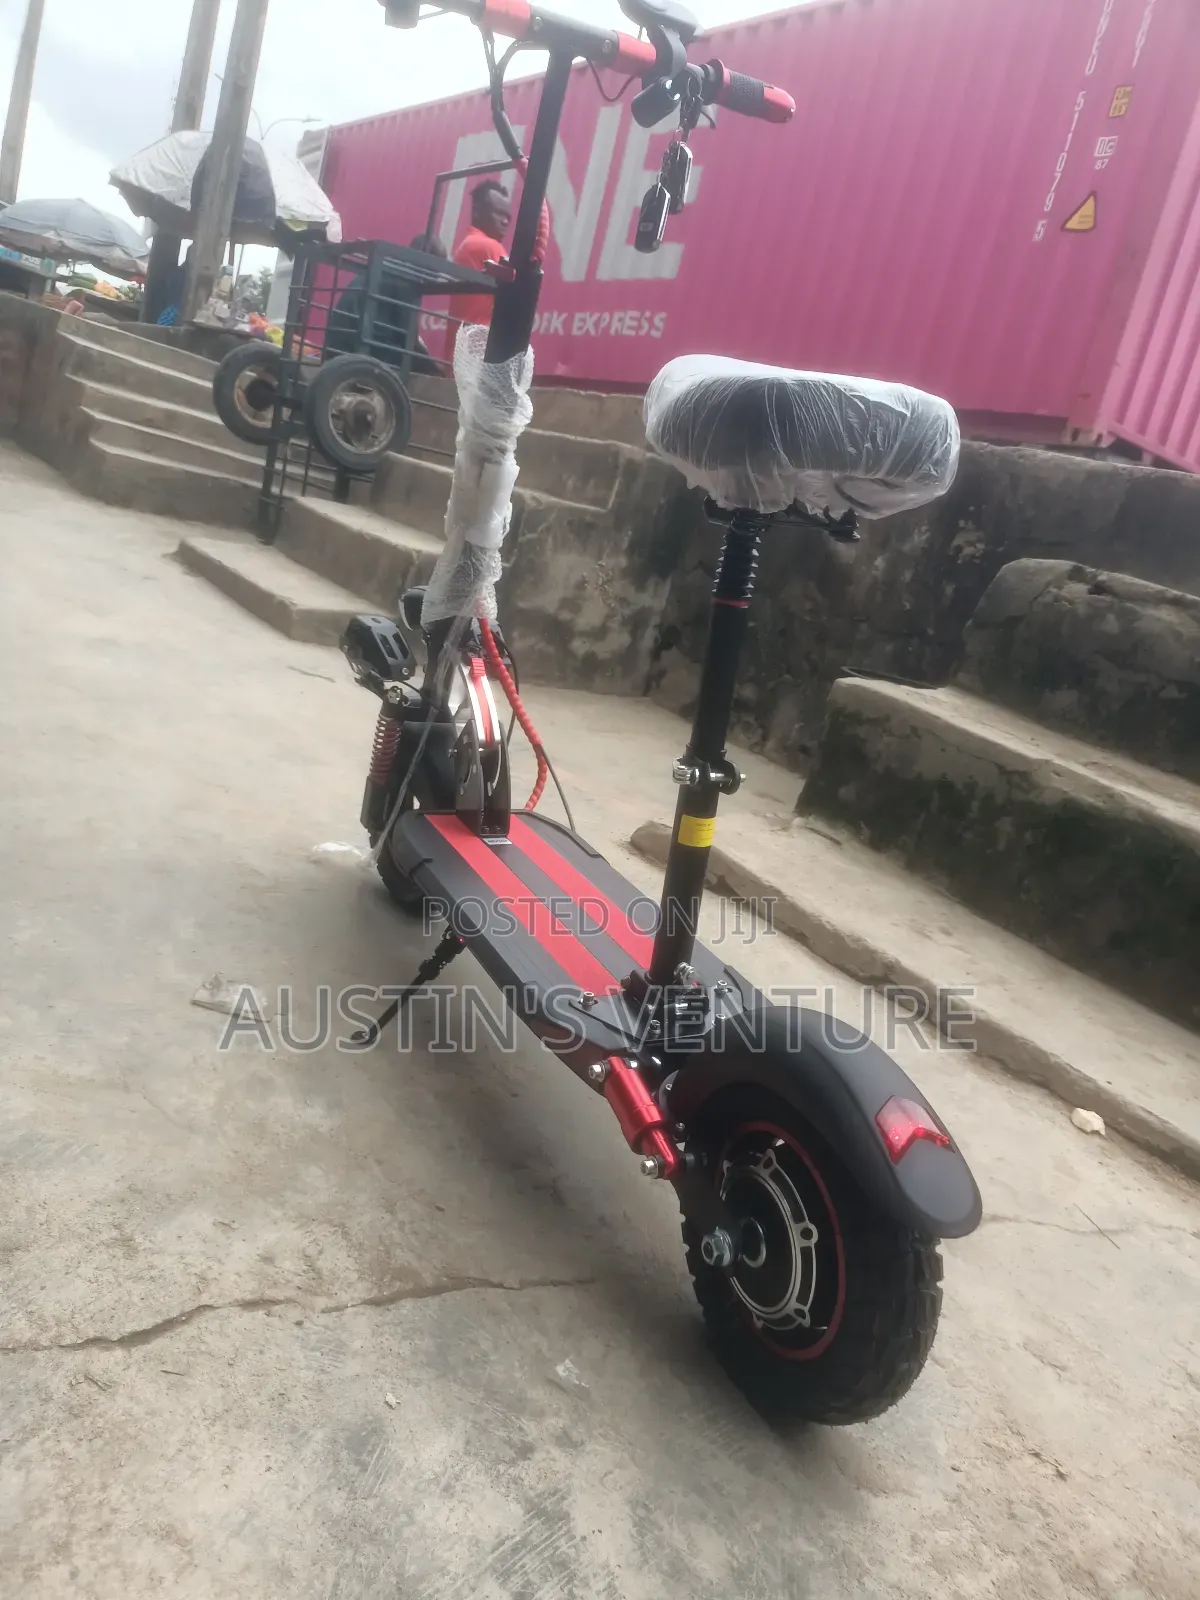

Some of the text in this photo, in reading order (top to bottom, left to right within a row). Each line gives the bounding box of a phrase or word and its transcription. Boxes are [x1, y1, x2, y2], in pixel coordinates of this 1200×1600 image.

[1044, 91, 1086, 211] 511079
[1034, 220, 1047, 241] 5
[571, 310, 667, 338] EXPRESS
